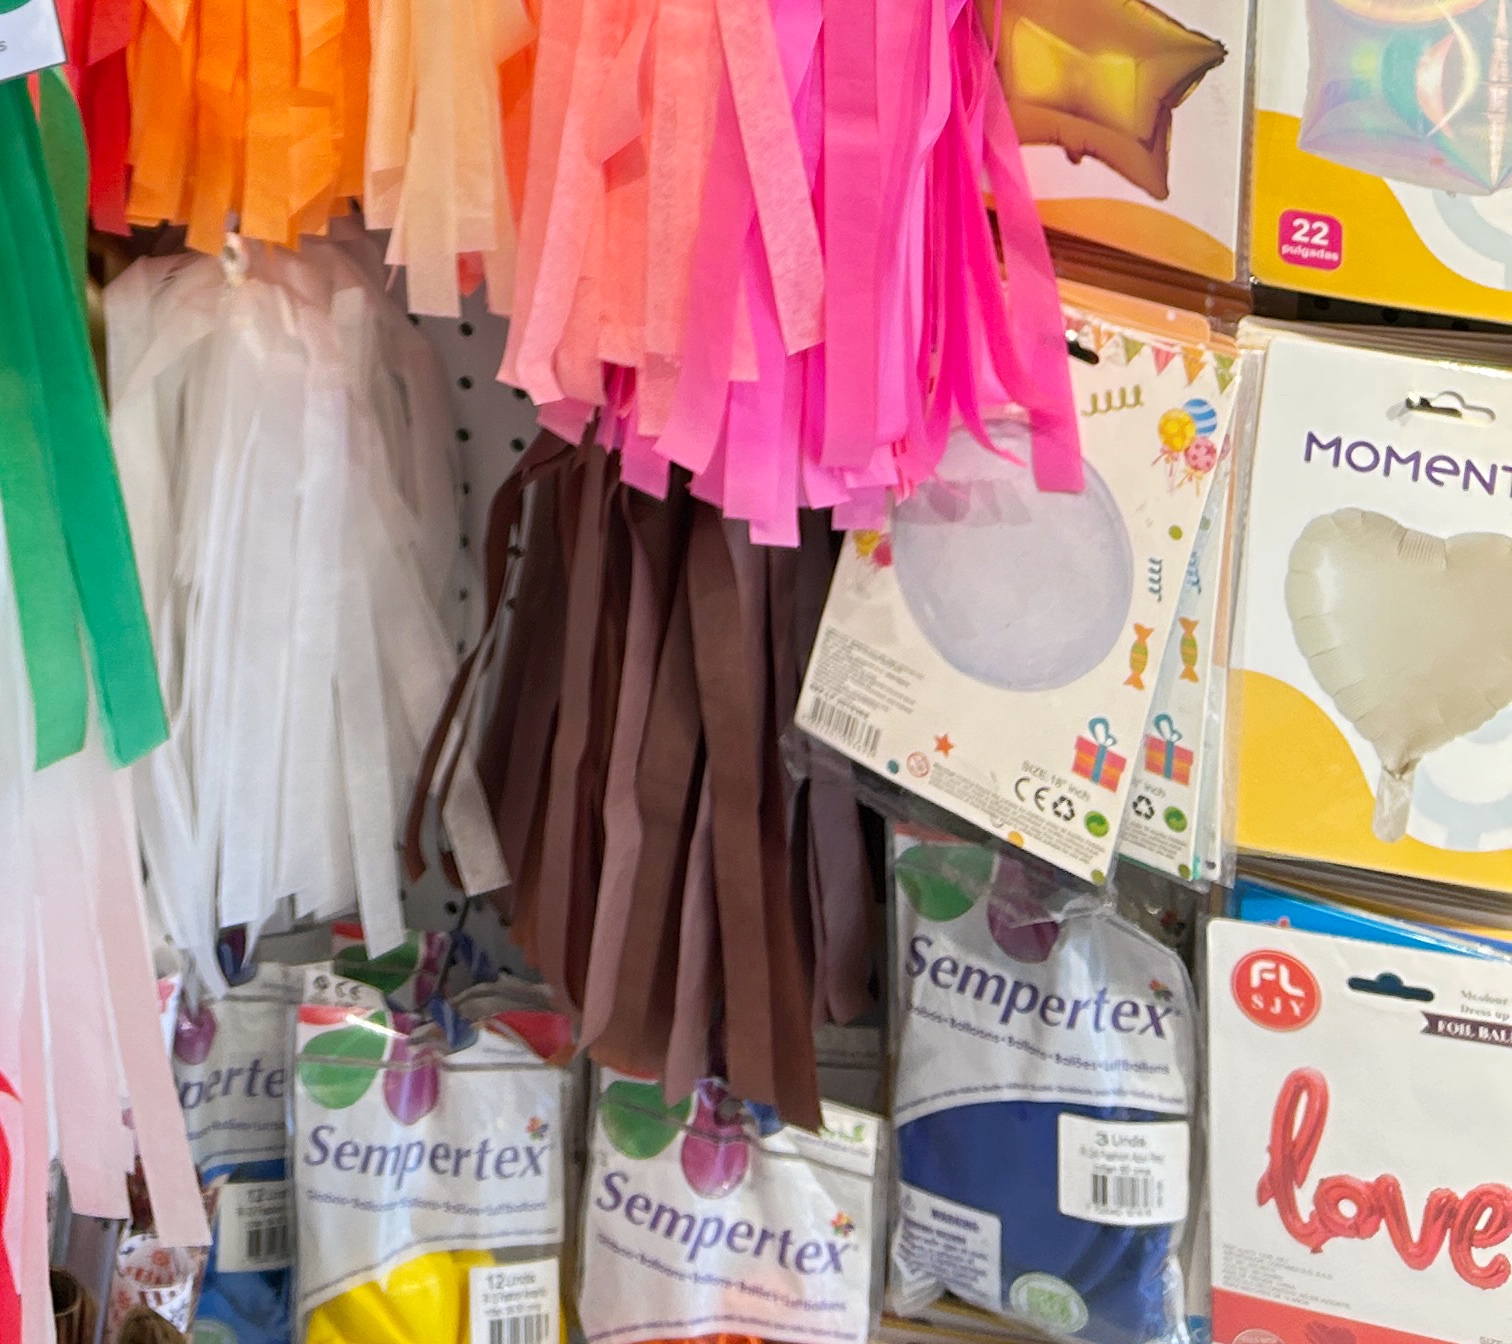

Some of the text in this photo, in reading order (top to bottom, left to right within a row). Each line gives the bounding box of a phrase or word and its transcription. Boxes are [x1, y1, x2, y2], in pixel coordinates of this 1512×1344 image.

[1290, 217, 1330, 247] 22
[1280, 243, 1340, 262] pulgadas
[904, 933, 1173, 1040] Sempertex
[1249, 959, 1306, 998] FL
[1437, 1019, 1512, 1044] FOIL BAL
[304, 1124, 550, 1192] Sempertex
[594, 1169, 852, 1277] Sempertex
